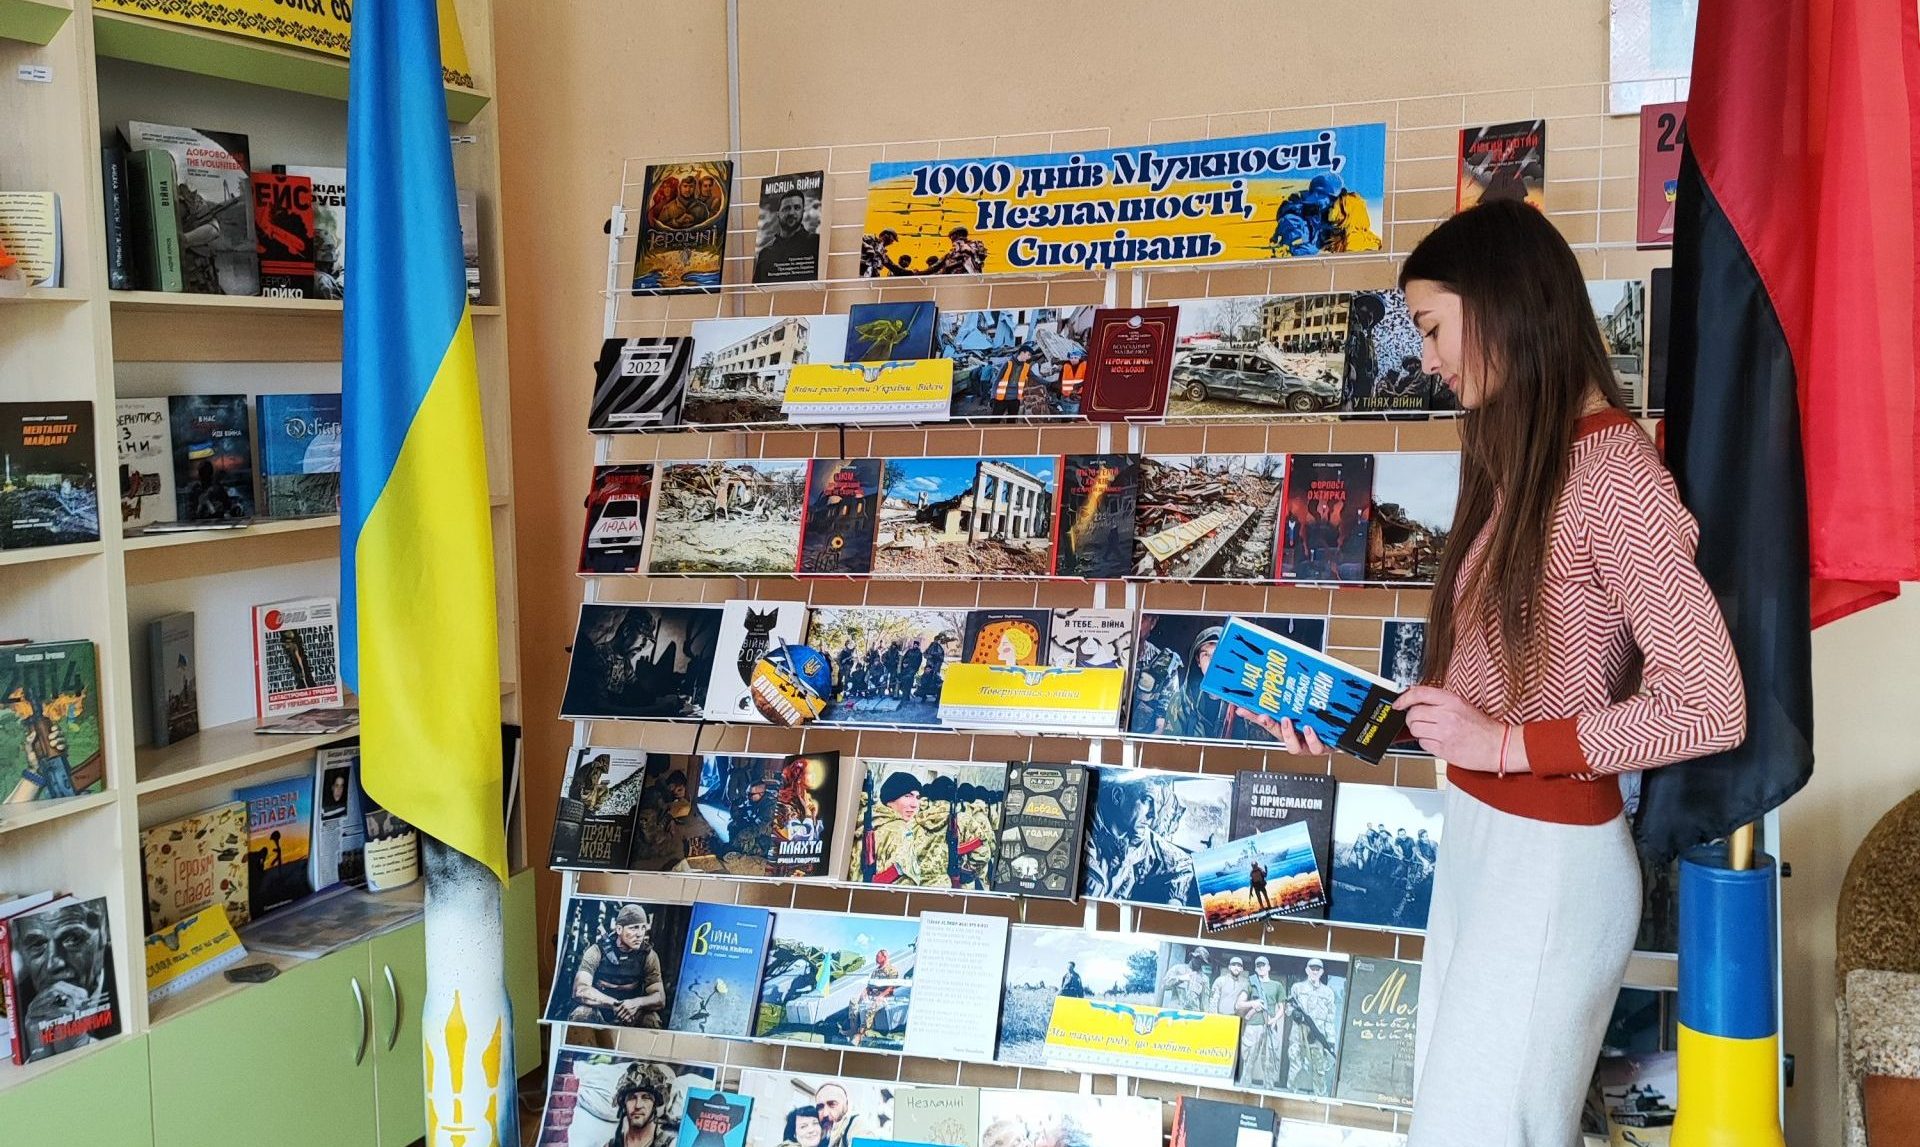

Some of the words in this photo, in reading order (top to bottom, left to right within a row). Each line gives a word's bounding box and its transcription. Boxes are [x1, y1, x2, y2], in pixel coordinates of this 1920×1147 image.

[913, 163, 1012, 197] 1000
[1017, 154, 1103, 198] днів
[1113, 132, 1343, 192] Мужності,
[159, 180, 170, 207] ВІЙНА
[764, 180, 795, 195] МІСЯЦЬ
[796, 176, 821, 190] ВІЙНИ
[252, 179, 313, 212] ЕЙС
[976, 181, 1254, 231] Незламності,
[1007, 229, 1223, 269] Сподівань
[626, 361, 661, 374] 2022
[1353, 396, 1360, 408] У
[1363, 396, 1390, 408] ТІНЯХ
[1392, 394, 1424, 408] ВІЙНИ
[1307, 490, 1346, 500] ОХТИРКА
[597, 519, 638, 534] ЛЮДИ
[1064, 620, 1070, 628] Я
[1101, 619, 1125, 629] ВІЙНА
[1241, 662, 1264, 691] НАД
[1258, 648, 1288, 714] ПРІРВОЮ
[1308, 670, 1335, 711] ВІЙНИ
[1252, 783, 1278, 796] КАВА
[1250, 795, 1258, 806] З
[1260, 795, 1323, 810] ПРИСМАКОМ
[250, 804, 297, 827] СЛАВА
[1250, 806, 1288, 819] ПОПЕЛУ
[581, 823, 622, 842] ПРЯМА
[778, 839, 823, 855] ПЛАХТА
[173, 853, 215, 886] Героям
[691, 921, 738, 956] ВІЙНА
[1050, 1027, 1066, 1038] Ми
